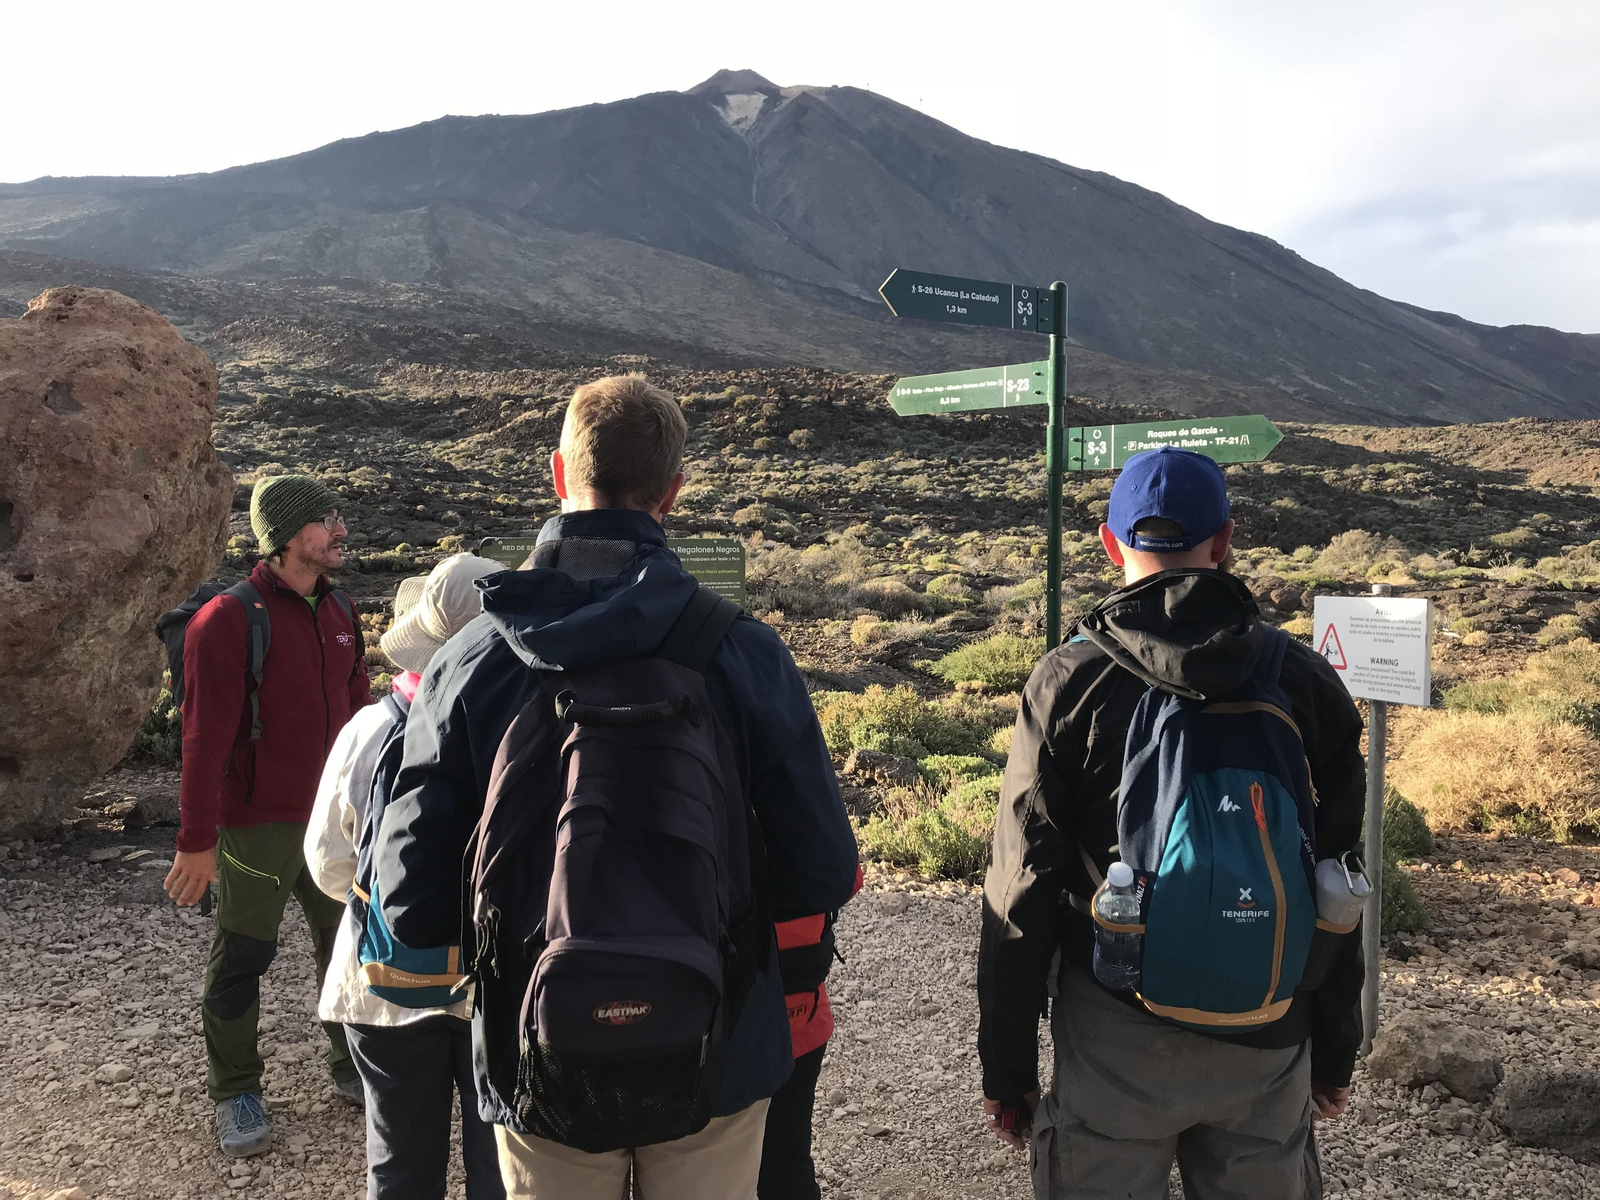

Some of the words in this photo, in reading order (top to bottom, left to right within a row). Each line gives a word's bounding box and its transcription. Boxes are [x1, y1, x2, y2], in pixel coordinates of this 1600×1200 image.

[918, 285, 934, 294] S-26
[934, 287, 958, 298] Ucanca
[960, 289, 970, 300] (La
[970, 292, 1000, 304] Catedral)
[946, 304, 956, 314] 1,3
[957, 306, 968, 314] km
[1017, 301, 1033, 316] S-3
[1006, 378, 1030, 393] S-23
[1148, 430, 1177, 440] Roques
[1178, 428, 1190, 437] de
[1191, 426, 1218, 436] García
[1087, 440, 1107, 456] S-3
[1169, 438, 1180, 448] La
[1181, 438, 1208, 448] Ruleta
[1214, 436, 1239, 446] TF-21
[678, 546, 714, 555] Regatones
[716, 546, 740, 555] Negros
[1370, 657, 1399, 667] WARNING
[1222, 910, 1270, 918] TENERIFE
[390, 972, 430, 984] Quechua
[598, 1006, 648, 1019] EASTPAK
